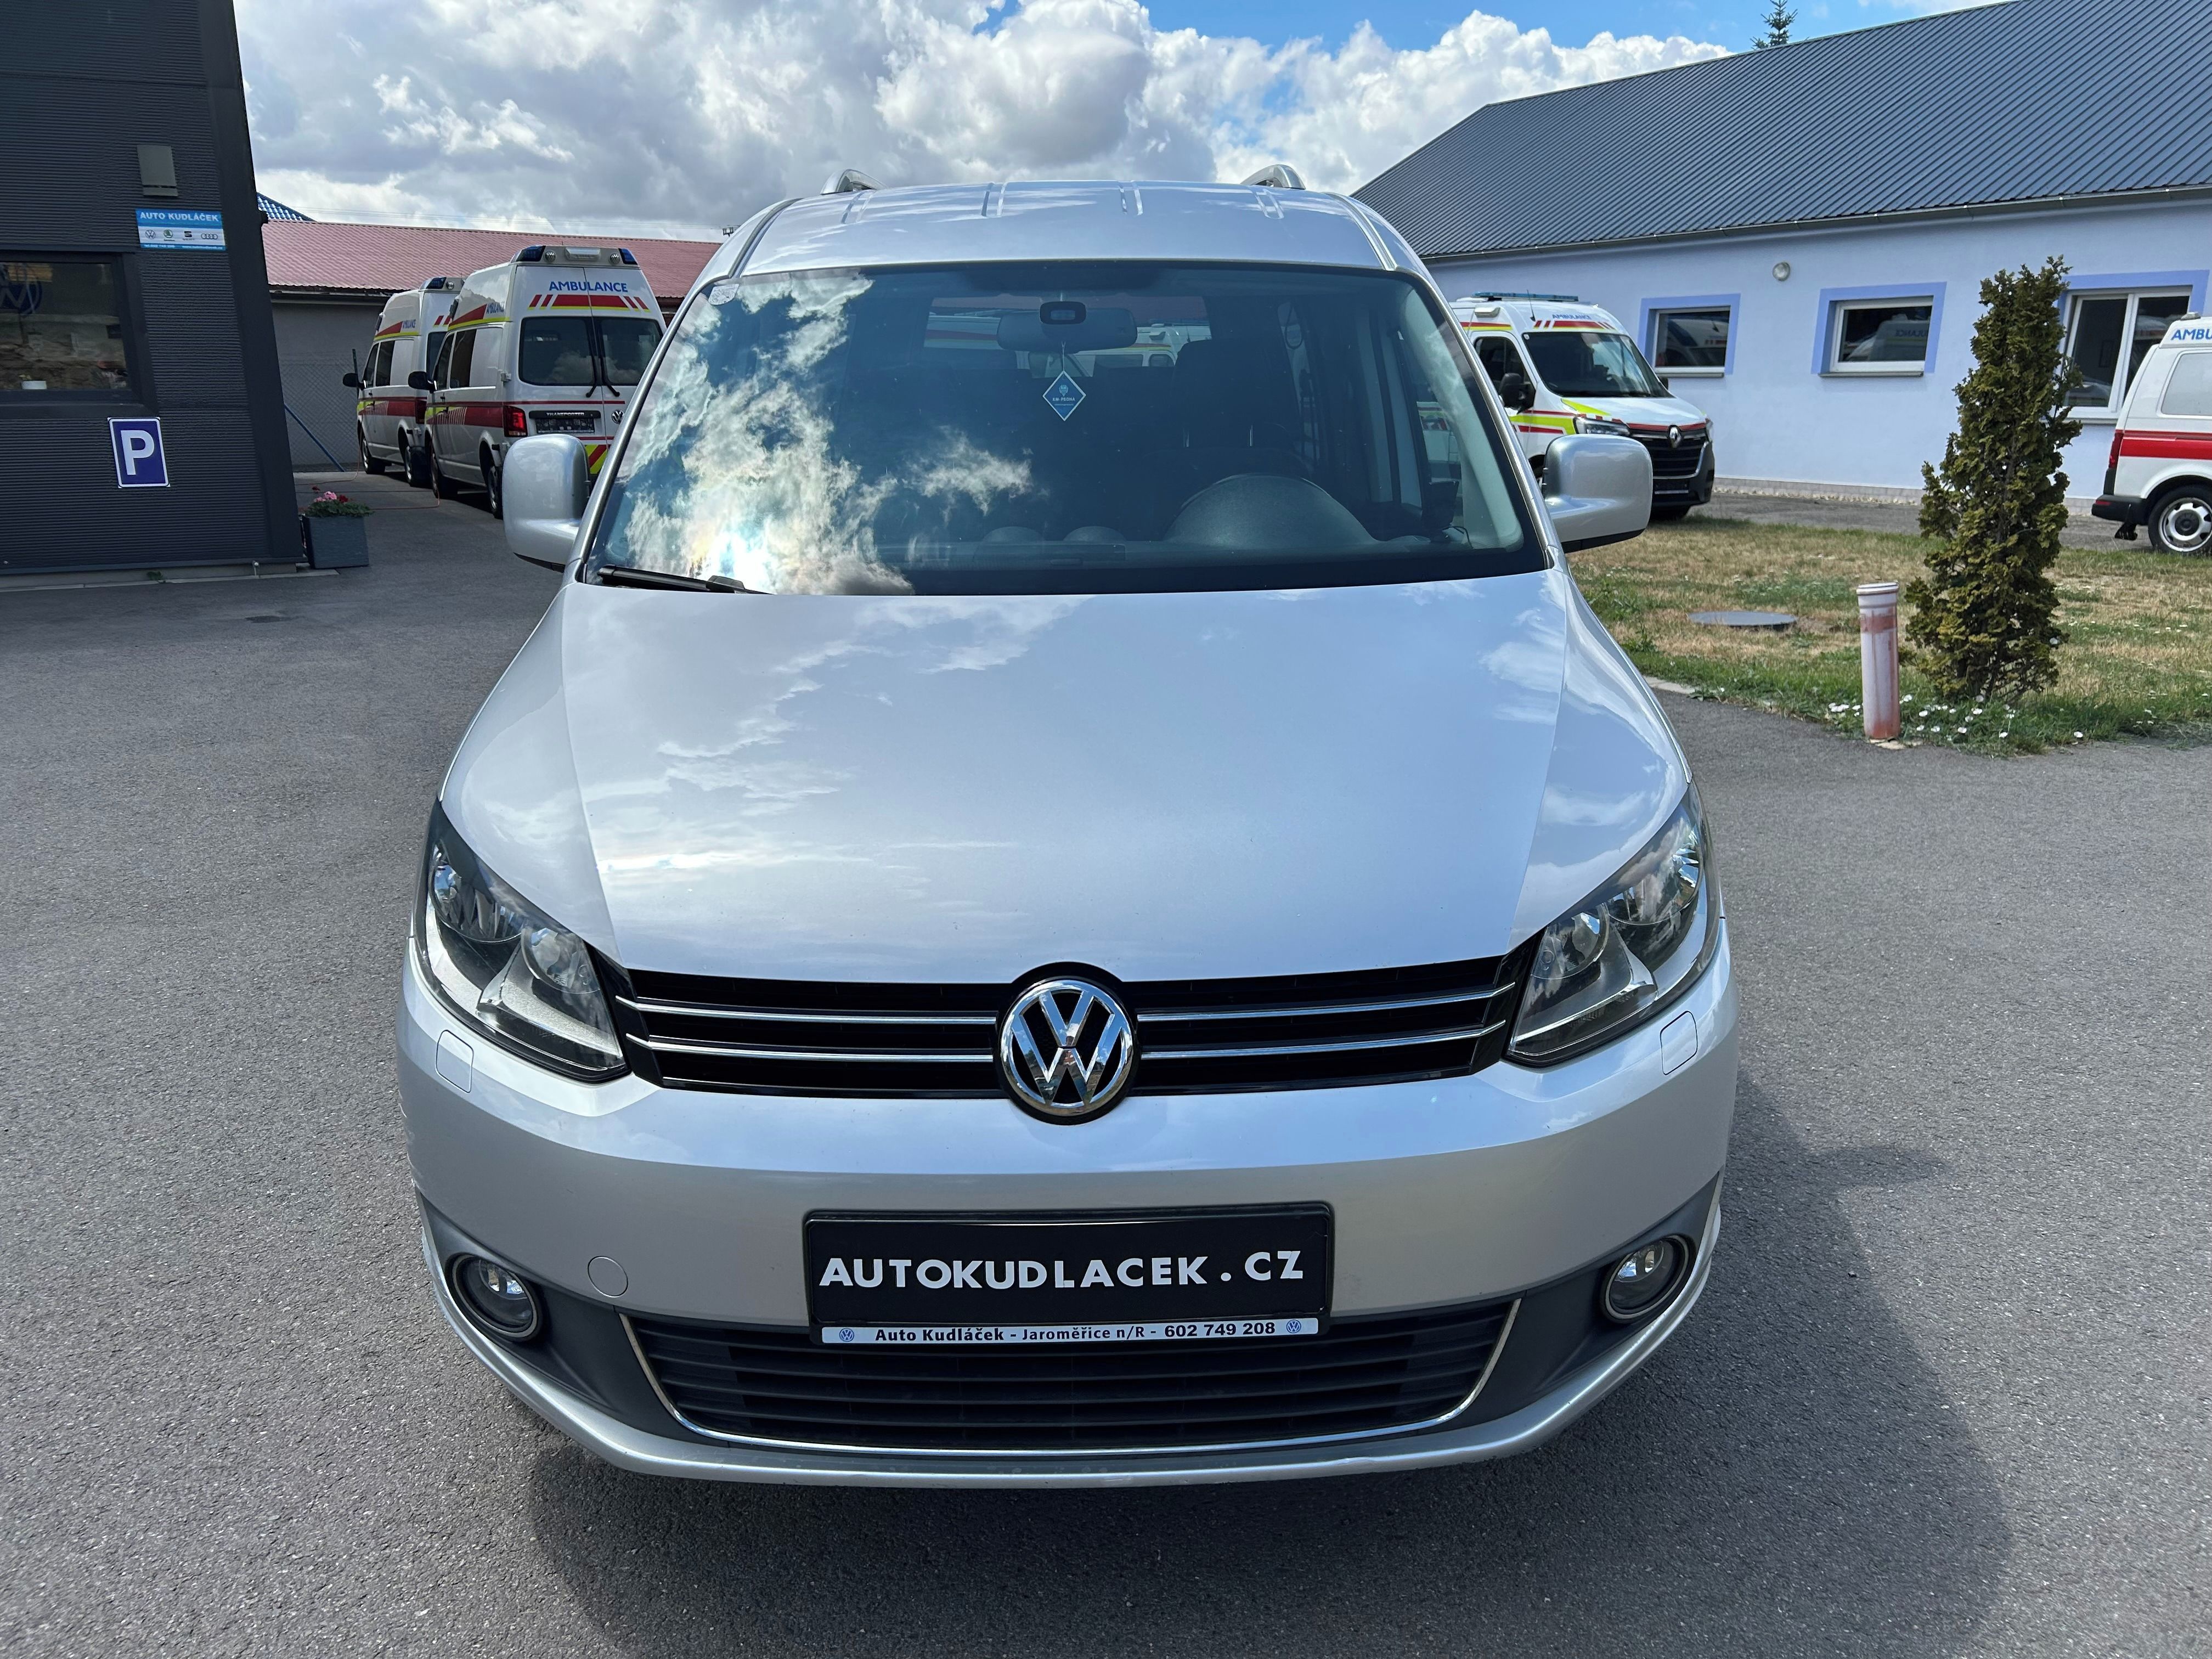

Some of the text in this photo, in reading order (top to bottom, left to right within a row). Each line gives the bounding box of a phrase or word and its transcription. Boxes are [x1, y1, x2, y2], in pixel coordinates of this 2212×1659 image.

[168, 212, 219, 222] KUDLÁČEK
[549, 281, 628, 292] AMBULANCE
[2171, 329, 2212, 340] AMBU
[120, 430, 155, 475] P
[875, 1329, 916, 1341] Auto
[923, 1328, 1004, 1341] Kudláček
[1022, 1326, 1110, 1341] Jaroměřice
[1116, 1325, 1145, 1339] n/R
[1164, 1325, 1198, 1337] 602
[1204, 1323, 1237, 1336] 749
[1243, 1322, 1276, 1334] 208
